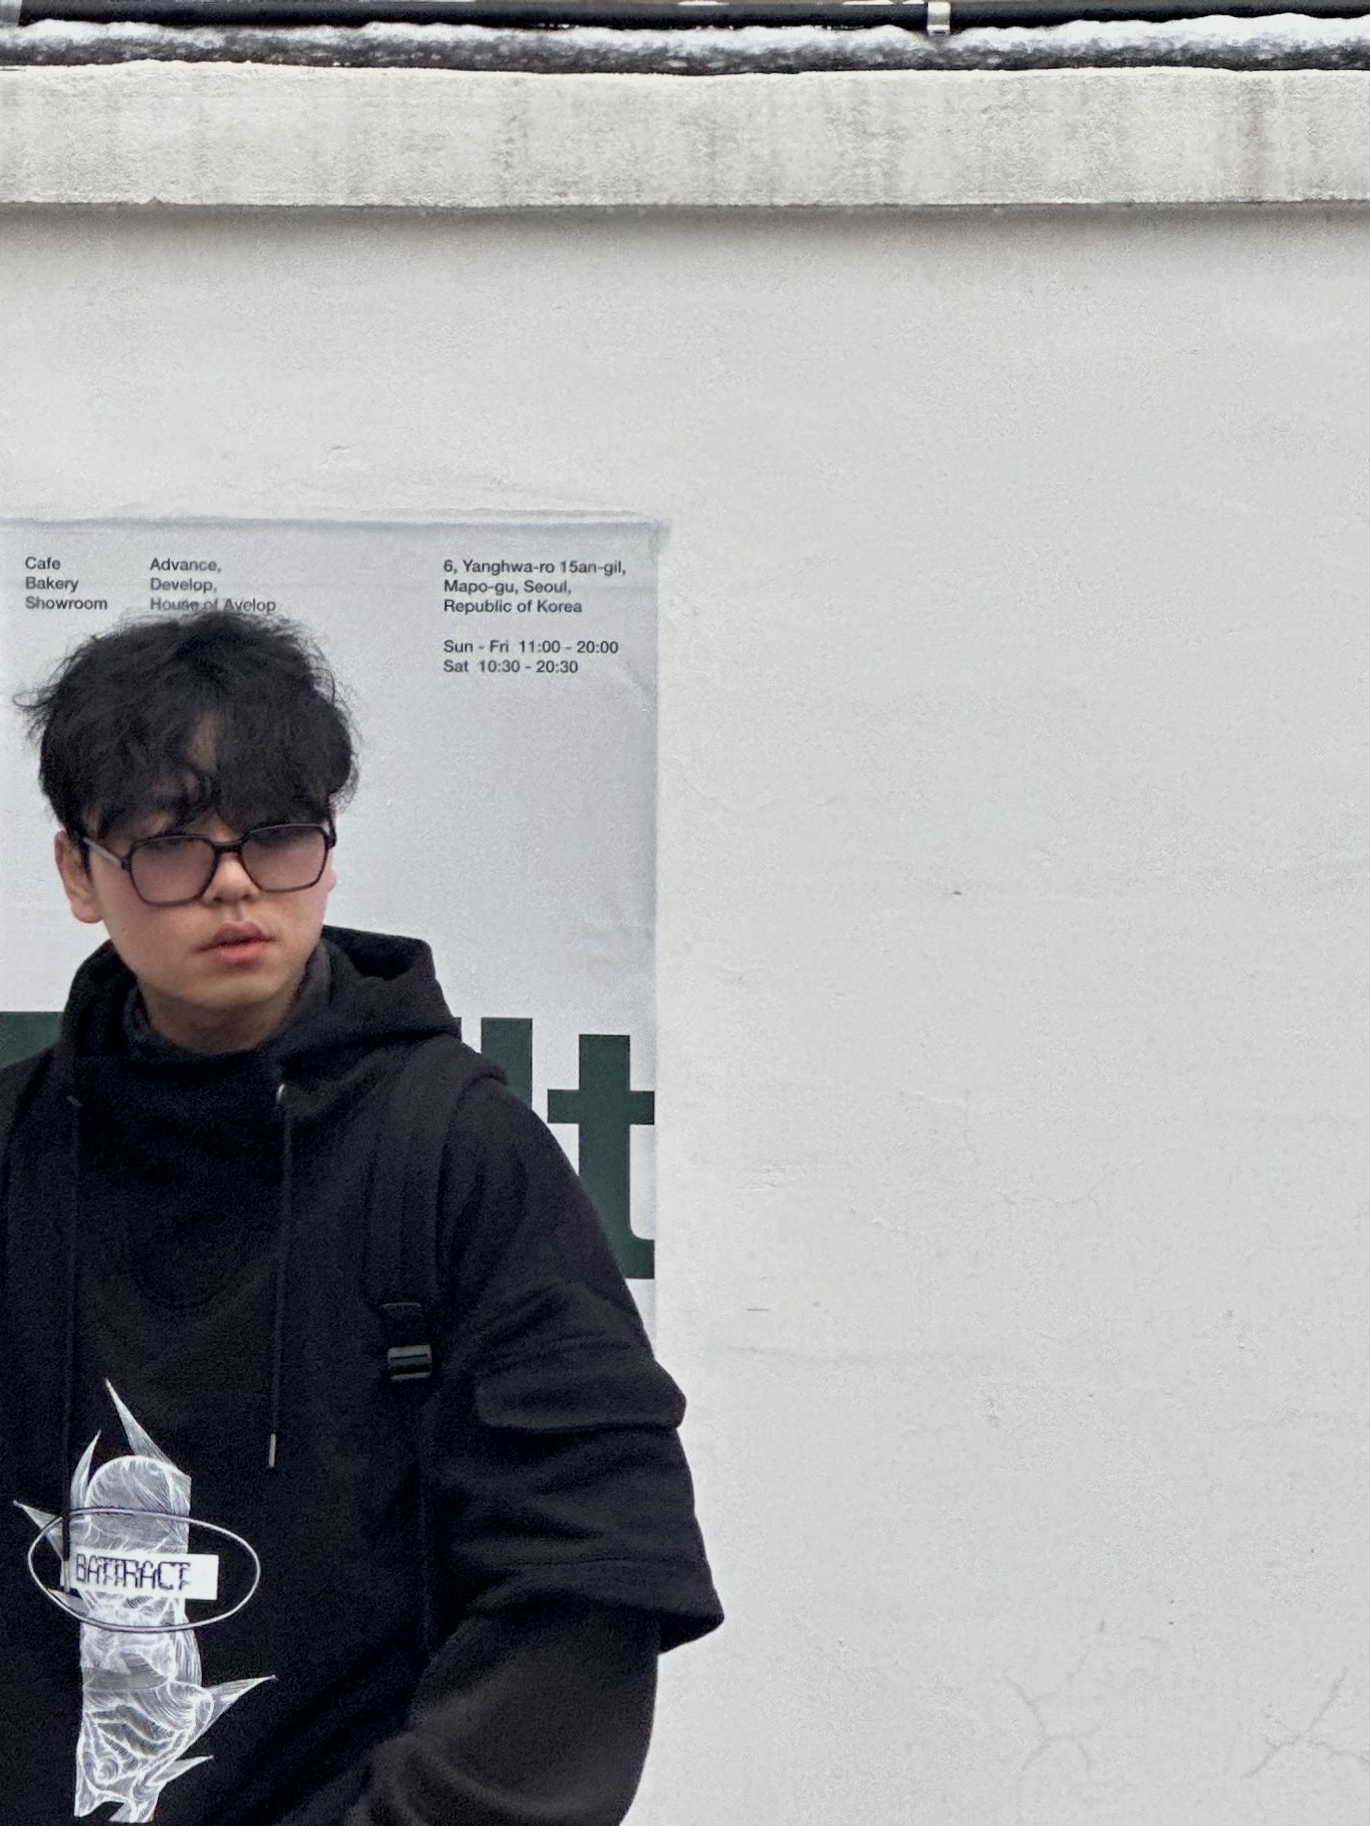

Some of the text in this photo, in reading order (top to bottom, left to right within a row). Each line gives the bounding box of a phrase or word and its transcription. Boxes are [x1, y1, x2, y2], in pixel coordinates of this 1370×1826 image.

[25, 557, 61, 570] Cafe
[149, 557, 222, 573] Advance,
[443, 559, 627, 576] 6, Yanghwa-ro 15an-gil,
[25, 576, 80, 593] Bakery
[149, 577, 218, 594] Develop,
[443, 579, 572, 596] Mapo-gu, Seoul,
[25, 596, 108, 610] Showroom
[150, 598, 199, 611] House
[224, 598, 277, 613] Avelop
[443, 598, 583, 615] Republic of Korea
[443, 639, 474, 654] Sun
[489, 639, 510, 654] Fri
[518, 640, 561, 654] 11:00
[576, 640, 620, 654] 20:00
[443, 659, 469, 673] Sat
[478, 660, 521, 674] 10:30
[535, 660, 579, 674] 20:30
